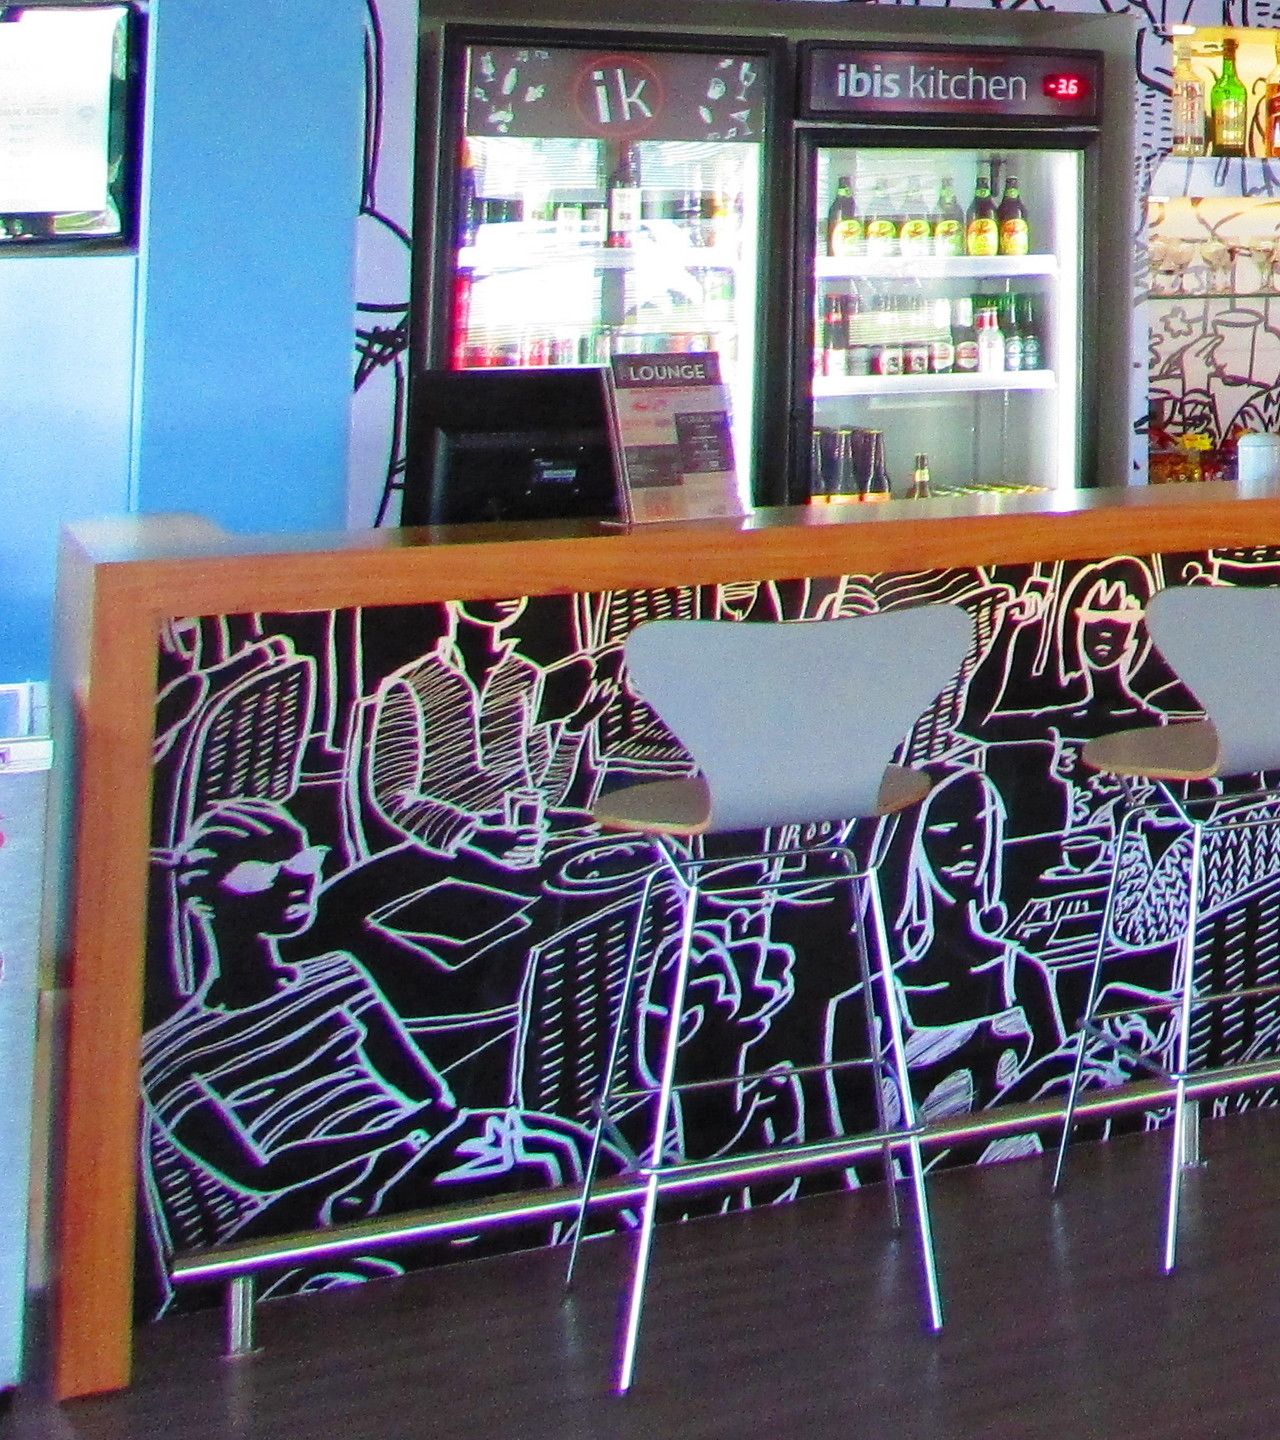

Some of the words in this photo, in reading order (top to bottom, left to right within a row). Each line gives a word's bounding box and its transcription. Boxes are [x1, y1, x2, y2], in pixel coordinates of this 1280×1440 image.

[837, 63, 901, 98] ibis
[909, 65, 1028, 101] kitchen
[629, 363, 706, 381] LOUNGE
